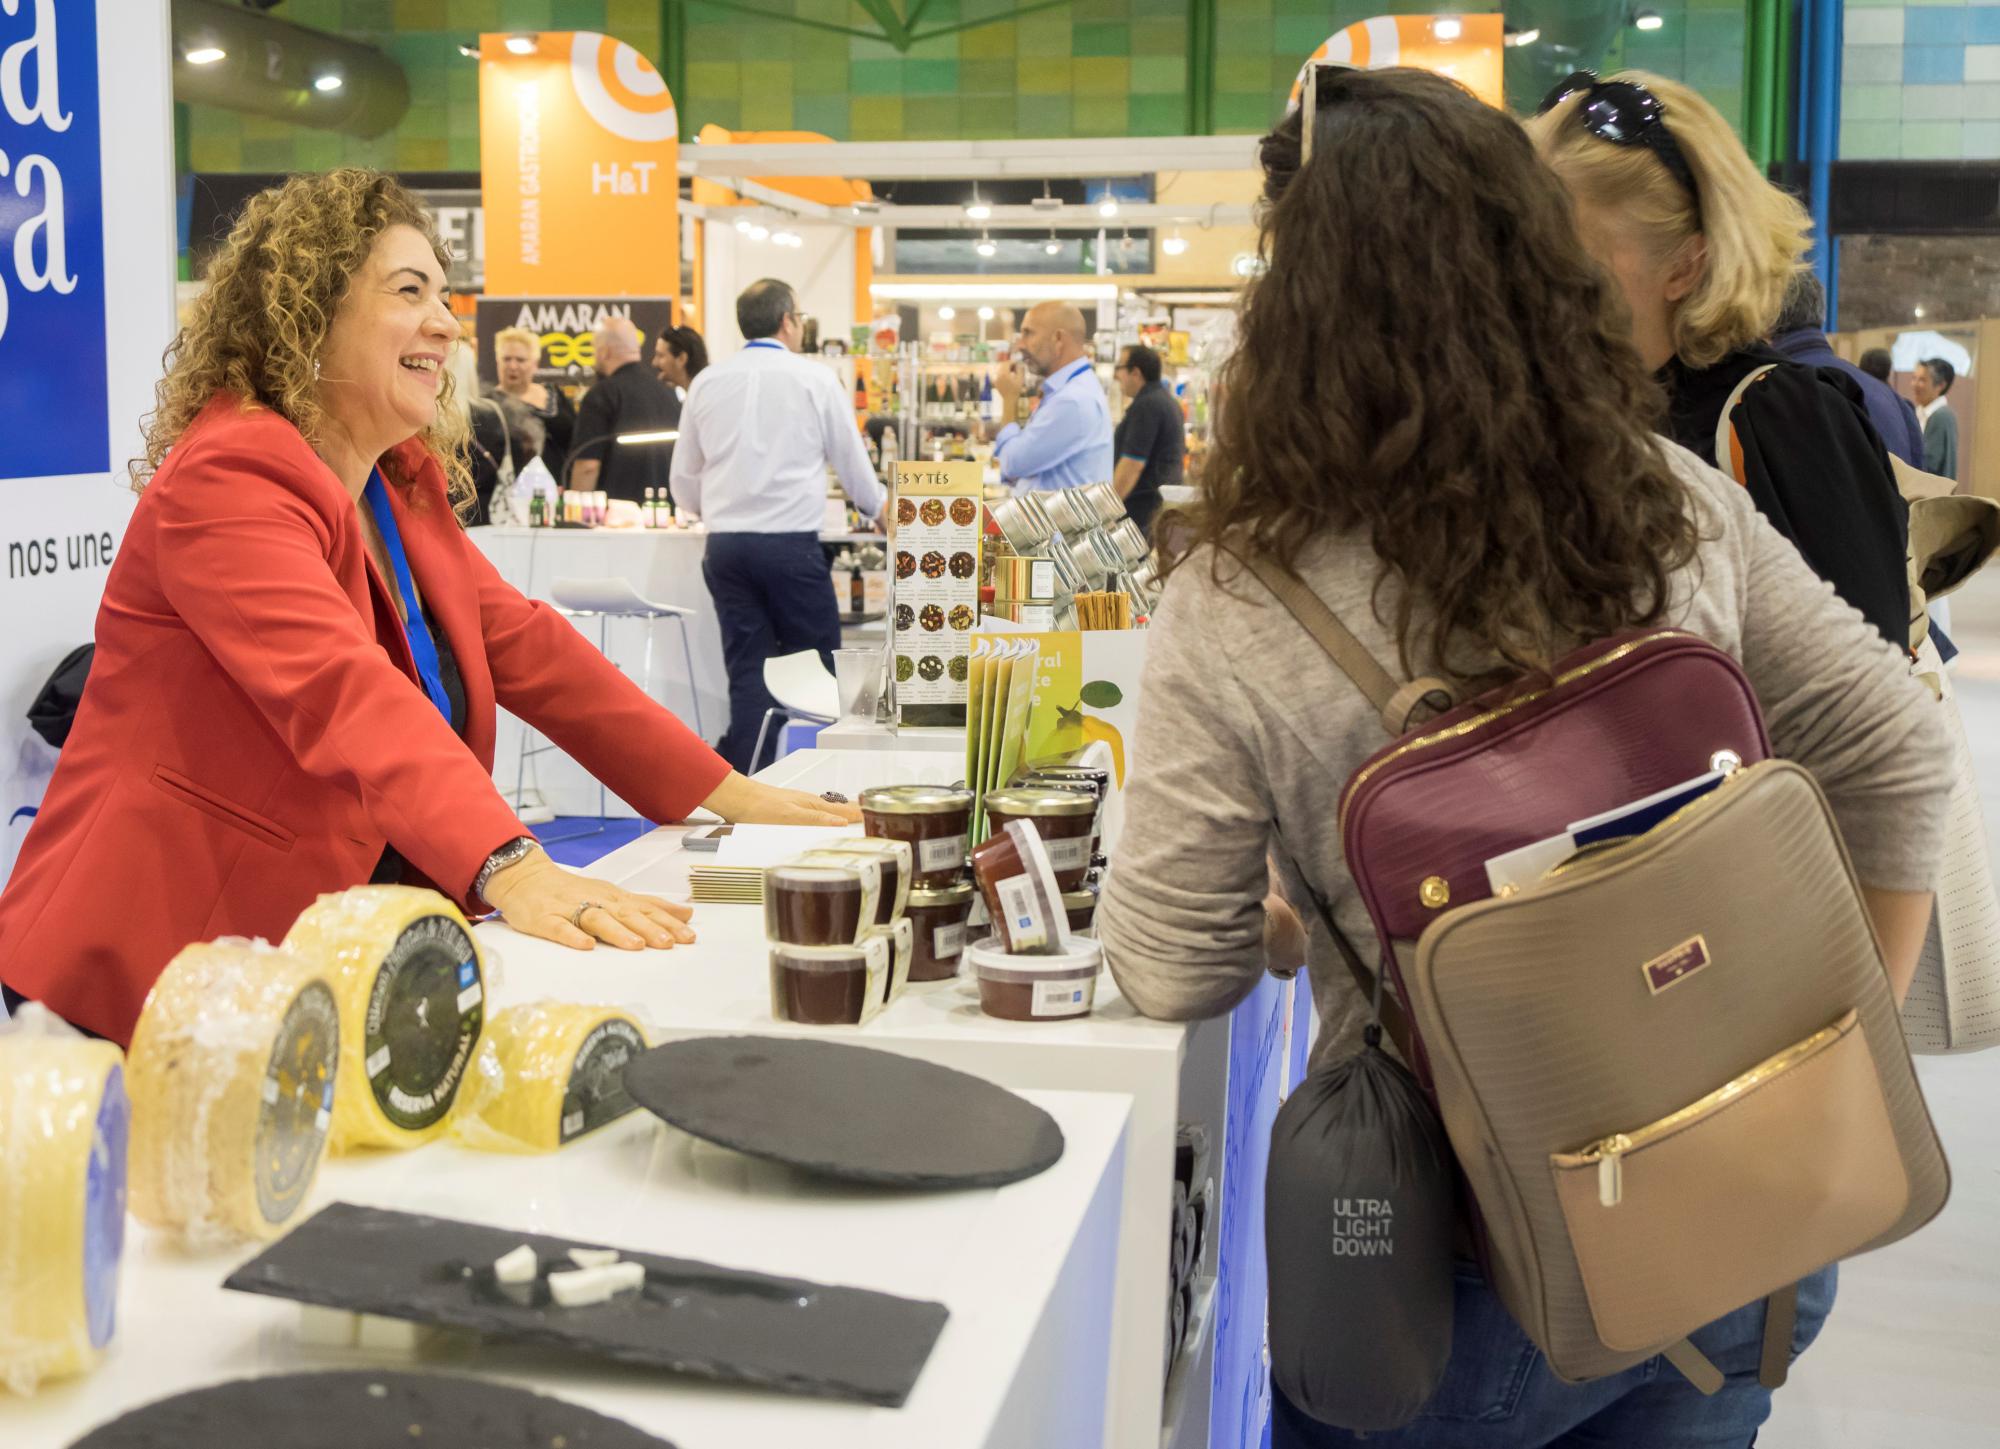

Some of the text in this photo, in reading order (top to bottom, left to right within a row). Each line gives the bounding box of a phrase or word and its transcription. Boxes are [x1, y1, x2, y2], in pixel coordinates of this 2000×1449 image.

[592, 161, 657, 195] H&T
[520, 198, 541, 266] AMARAN
[913, 473, 924, 484] Y
[926, 471, 949, 485] TÉS
[9, 531, 113, 579] nos une
[1333, 1198, 1393, 1217] ULTRA
[1333, 1218, 1393, 1237] LIGHT
[1333, 1237, 1393, 1257] DOWN
